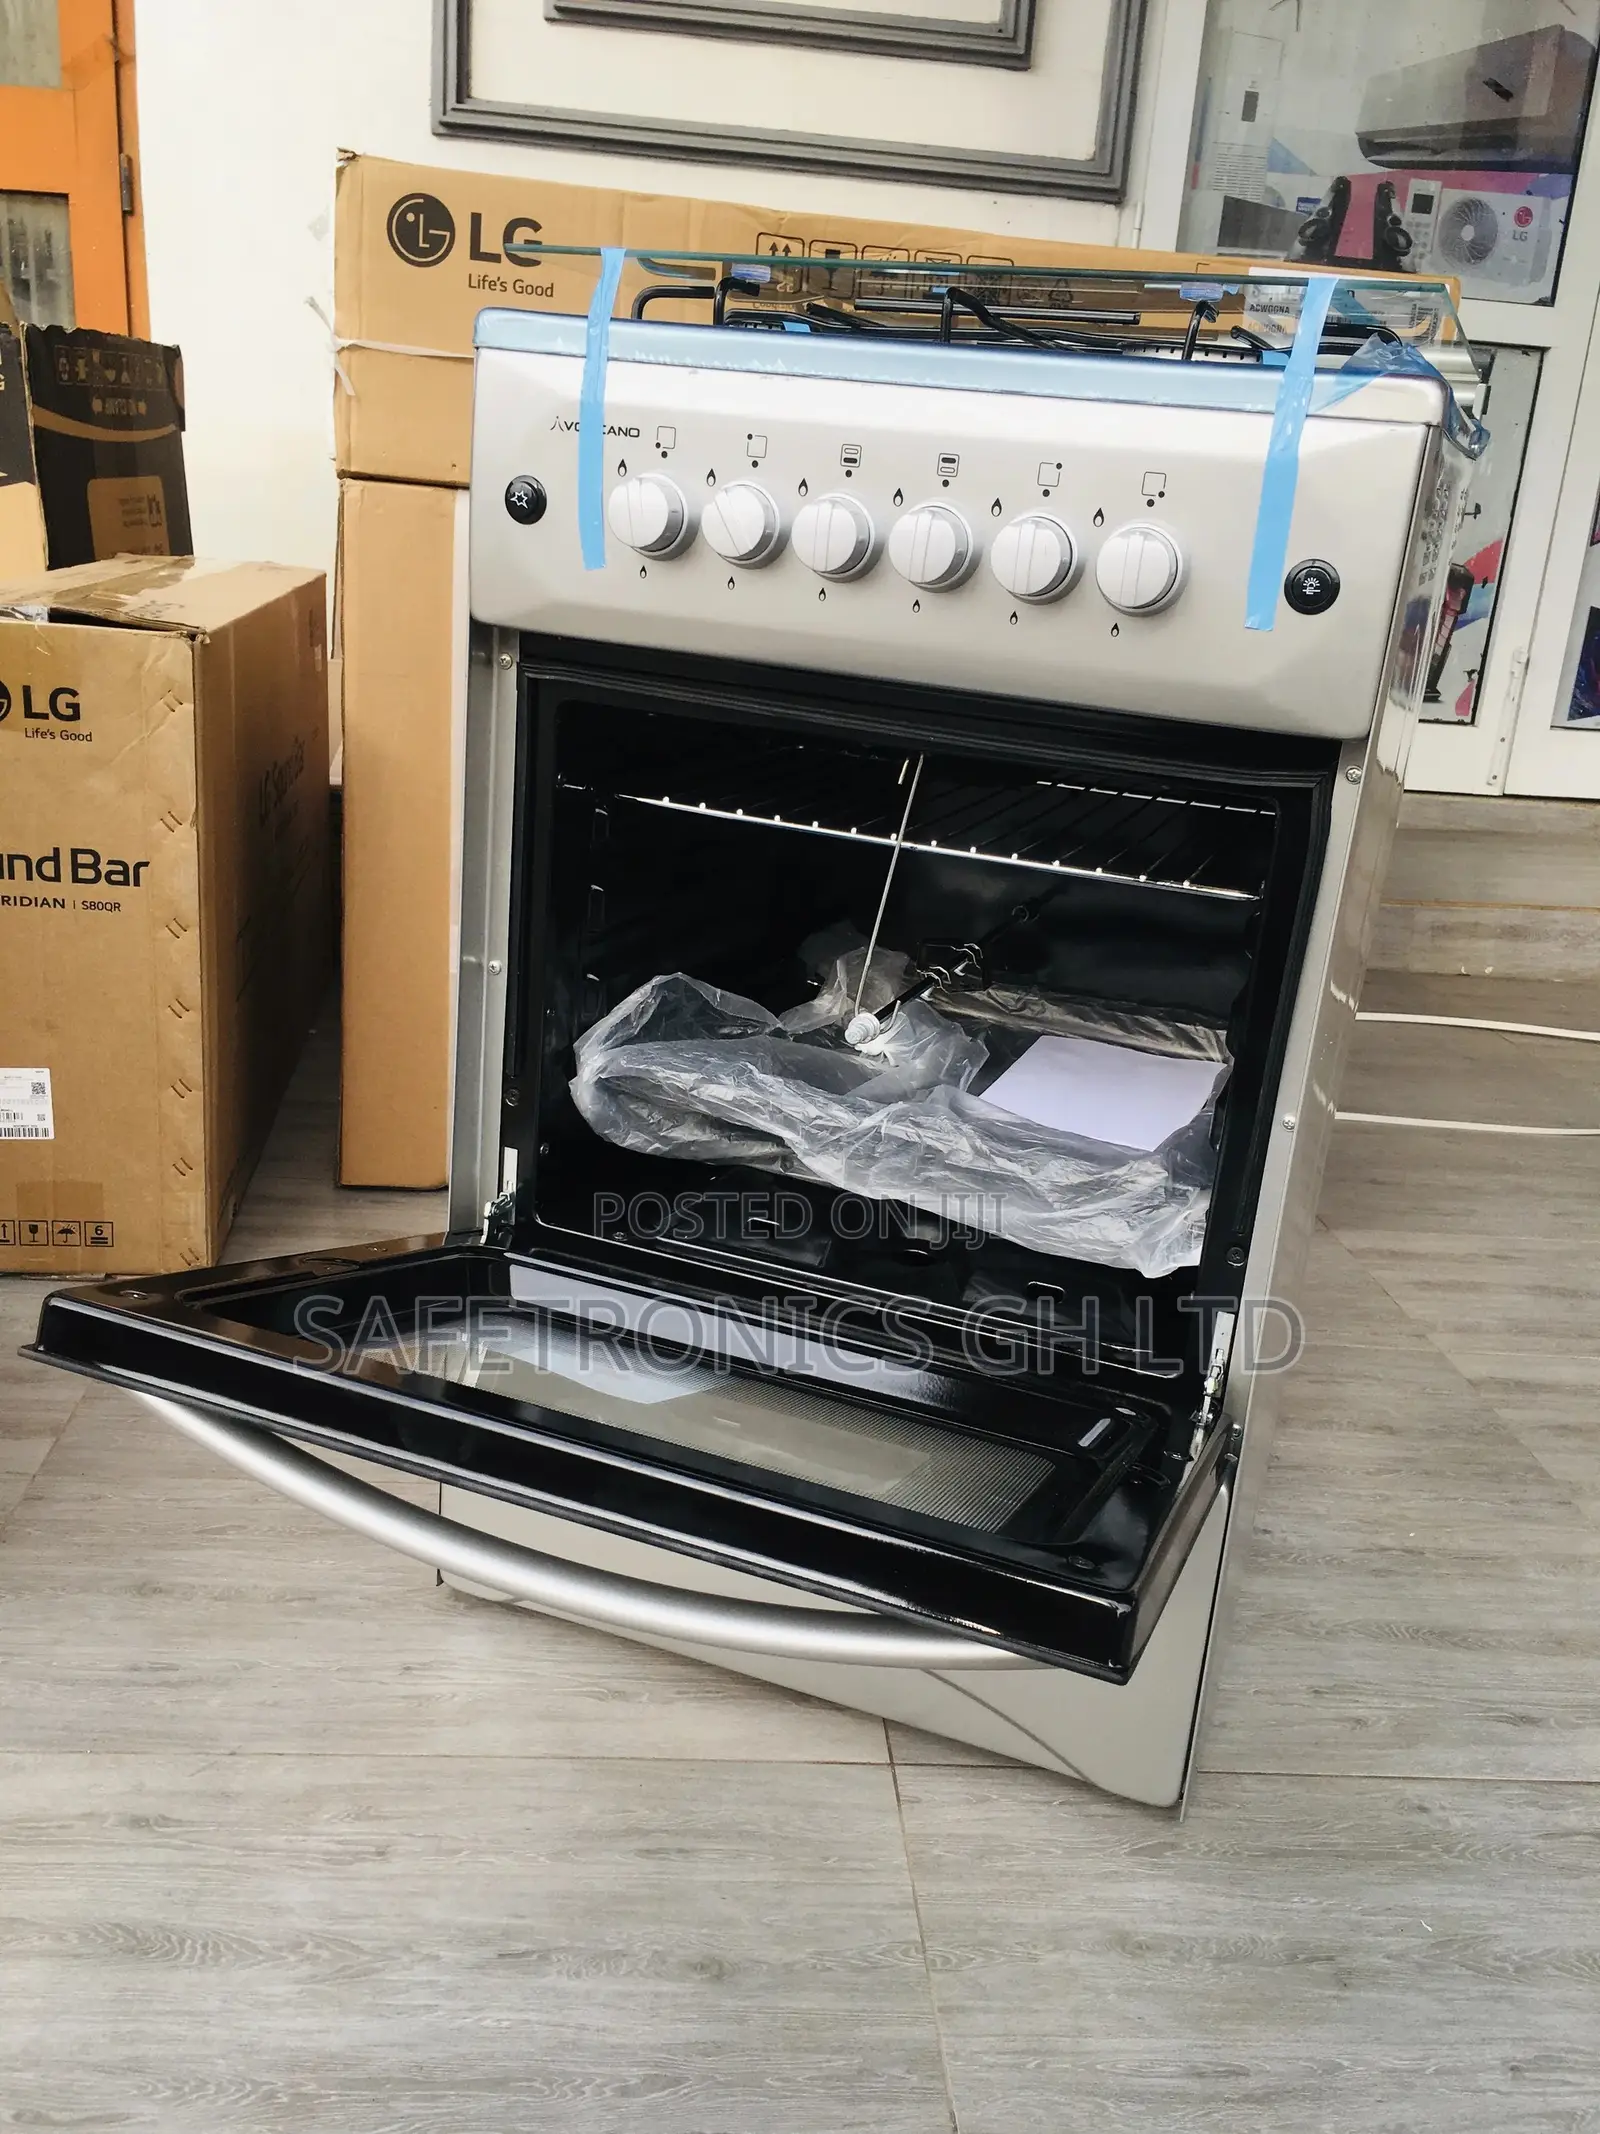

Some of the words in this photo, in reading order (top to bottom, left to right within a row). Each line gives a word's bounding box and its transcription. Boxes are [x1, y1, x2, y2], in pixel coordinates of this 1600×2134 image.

[470, 211, 543, 268] LG
[1512, 229, 1528, 242] LG
[468, 273, 508, 292] Life's
[512, 277, 555, 298] Good
[563, 420, 640, 438] VANO
[22, 684, 81, 722] LG
[25, 727, 56, 740] Life's
[60, 729, 93, 742] Good
[0, 847, 62, 883] nd
[70, 847, 151, 888] Bar
[81, 900, 122, 913] S80QR
[94, 1225, 104, 1236] 6
